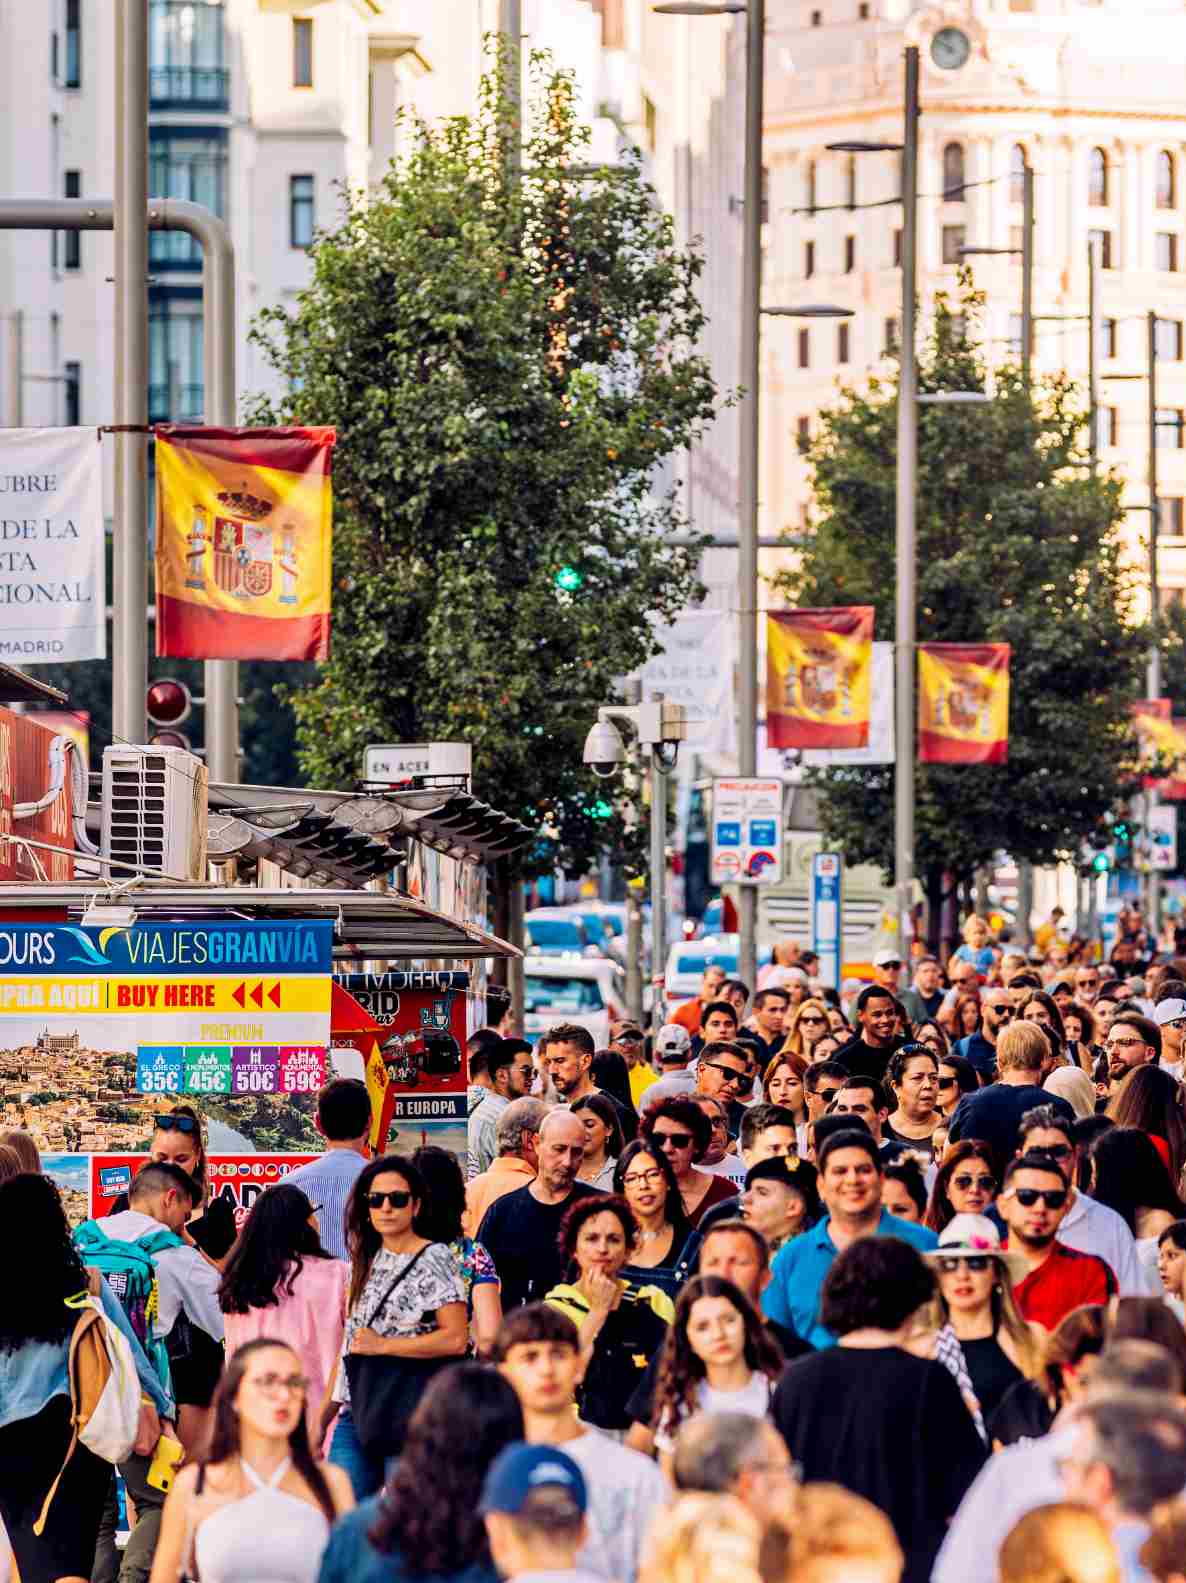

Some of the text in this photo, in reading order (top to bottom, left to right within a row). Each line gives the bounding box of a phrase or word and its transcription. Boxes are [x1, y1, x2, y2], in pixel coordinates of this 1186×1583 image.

[1, 519, 80, 540] DE LA
[0, 640, 64, 655] MADRID
[0, 932, 56, 965] OURS
[117, 984, 159, 1008] BUY
[164, 984, 216, 1008] HERE
[199, 1023, 265, 1041] PREMIUM
[141, 1072, 179, 1092] 35€
[188, 1072, 226, 1092] 45€
[236, 1072, 274, 1092] 50€
[283, 1072, 322, 1092] 59€
[406, 1100, 457, 1115] EUROPA
